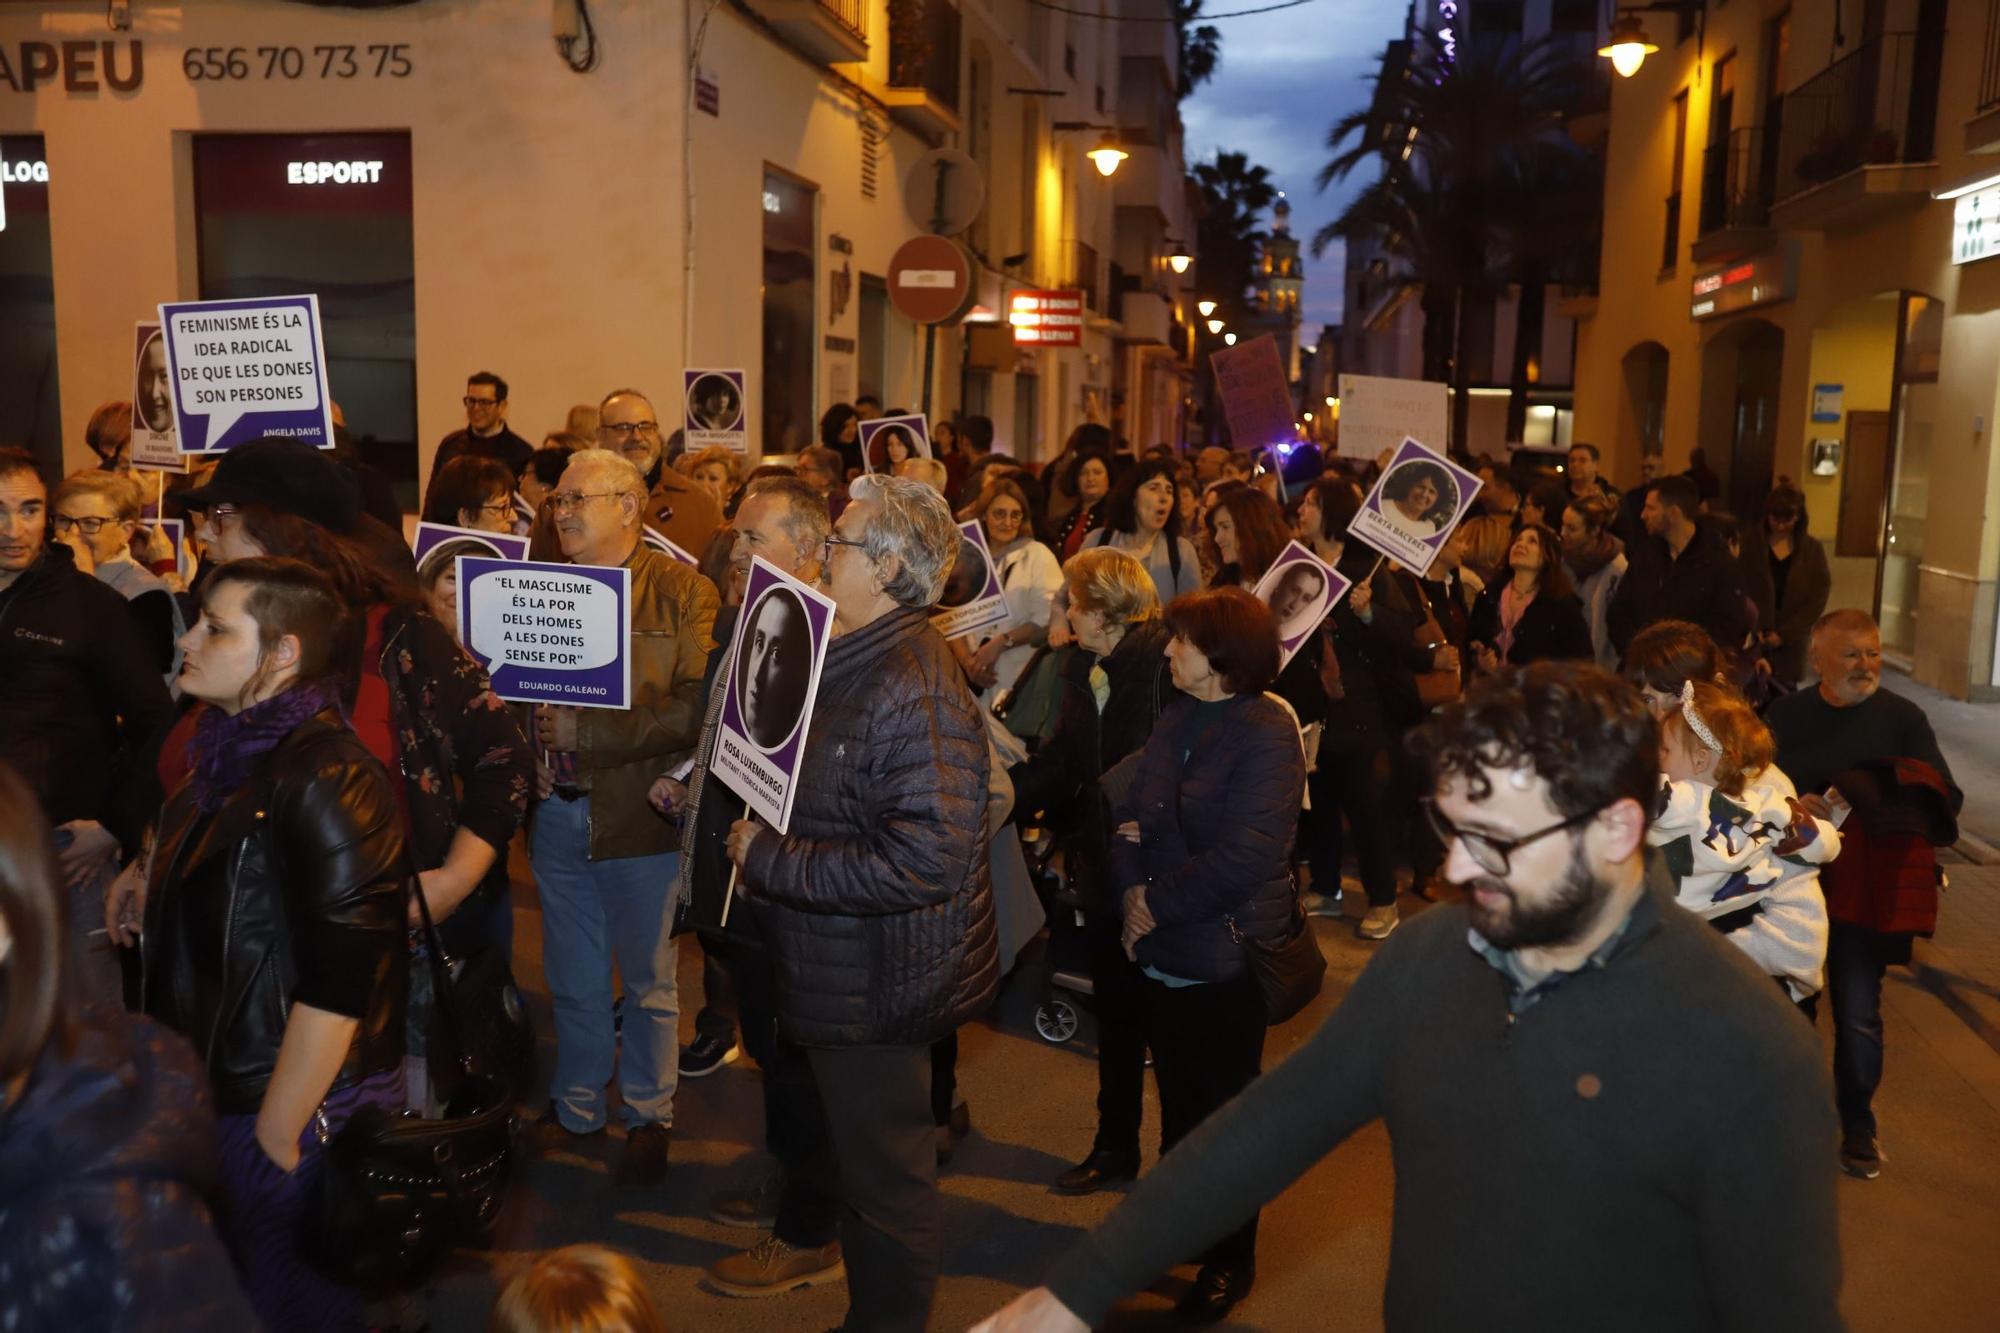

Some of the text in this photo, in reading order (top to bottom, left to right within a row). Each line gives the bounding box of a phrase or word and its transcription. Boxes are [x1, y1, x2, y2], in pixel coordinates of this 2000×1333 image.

[182, 44, 413, 81] 656 70 73 75
[287, 160, 384, 185] ESPORT
[179, 312, 302, 333] FEMINISME ÉS LA
[194, 339, 293, 356] IDEA RADICAL
[181, 362, 313, 381] DE QUE LES DONES
[196, 386, 304, 403] SON PERSONES
[263, 427, 321, 437] ANGELA DAVIS
[1367, 512, 1393, 531] BERTA
[494, 577, 593, 595] "EL MASCLISME
[512, 594, 576, 611] ÉS LA POR
[502, 613, 583, 630] DELS HOMES
[503, 631, 585, 647] A LES DONES
[505, 649, 583, 665] SENSE POR"
[518, 680, 608, 696] EDUARDO GALEANO
[723, 739, 783, 796] ROSA LUXEMBURGO
[720, 754, 740, 776] MILITANT
[758, 788, 780, 812] MARXISTA
